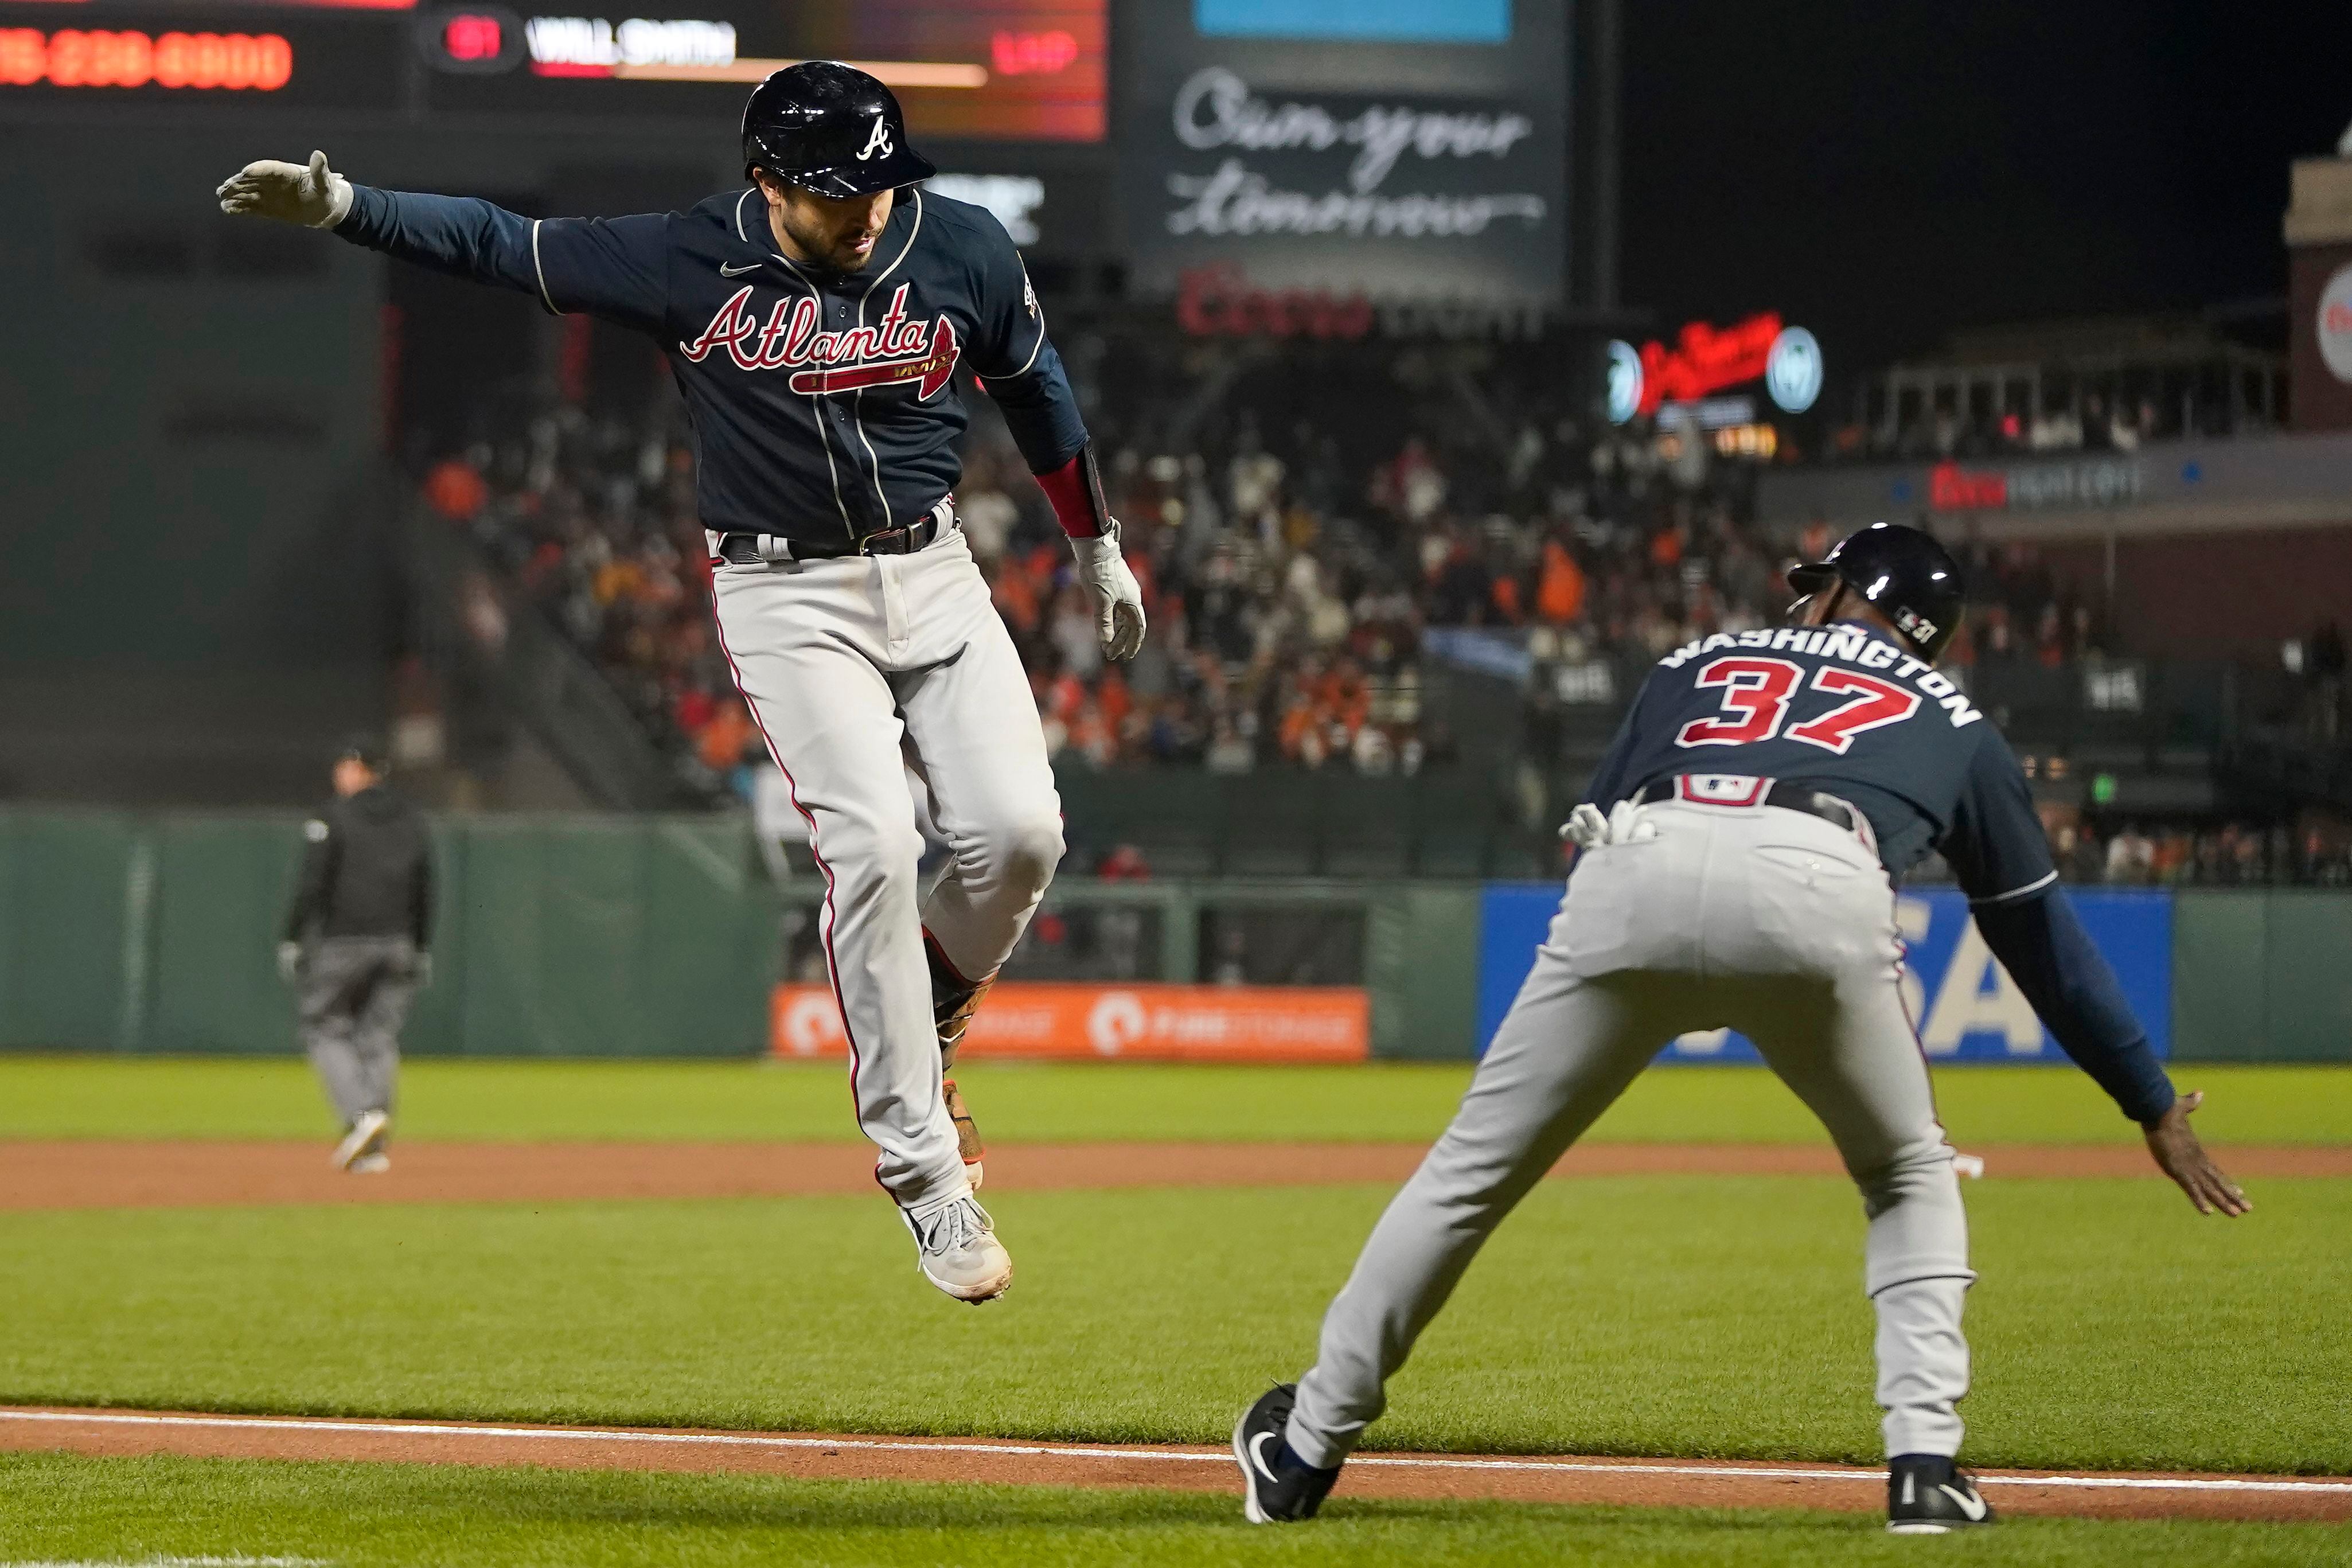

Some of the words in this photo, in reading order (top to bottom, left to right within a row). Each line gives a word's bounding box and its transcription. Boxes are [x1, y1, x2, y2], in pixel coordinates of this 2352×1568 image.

[856, 115, 894, 161] A
[680, 282, 929, 370] Atlanta
[1658, 629, 1983, 728] WASHINGTON
[1675, 656, 1921, 755] 37
